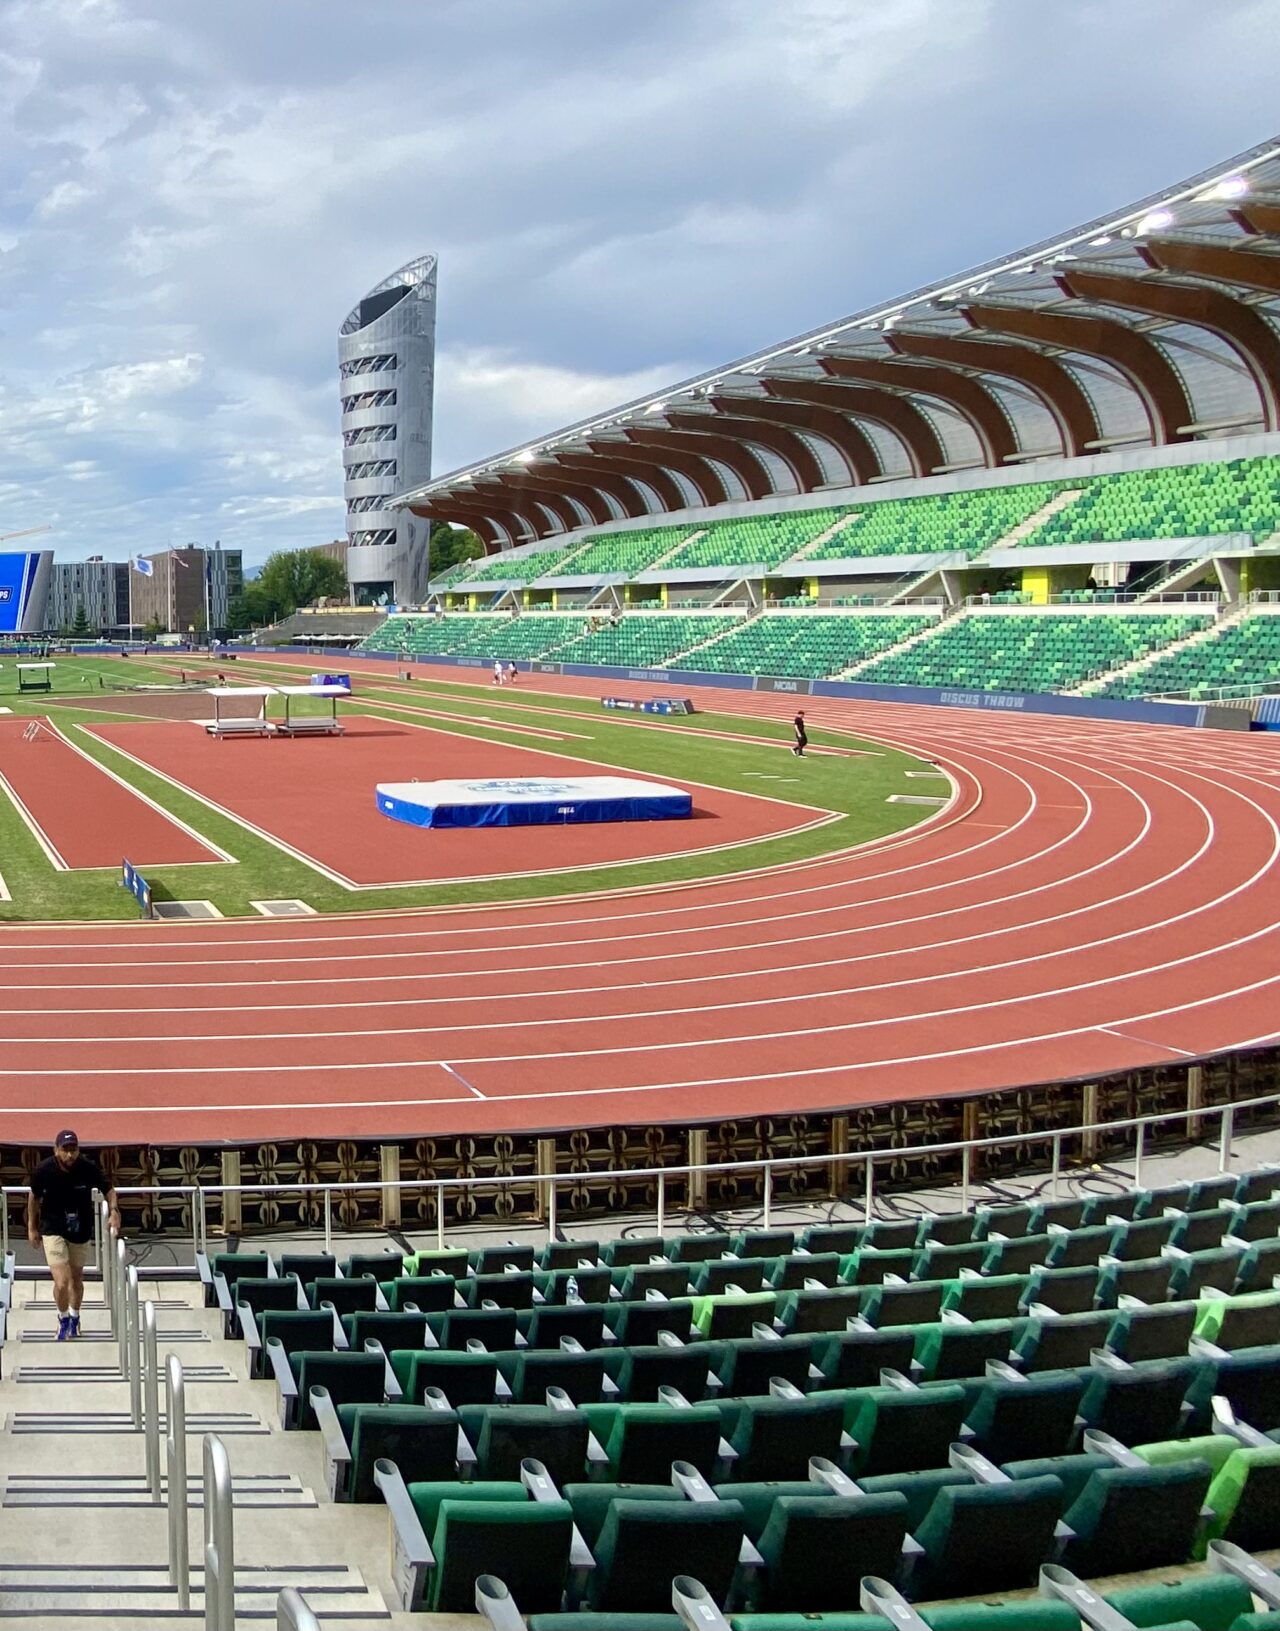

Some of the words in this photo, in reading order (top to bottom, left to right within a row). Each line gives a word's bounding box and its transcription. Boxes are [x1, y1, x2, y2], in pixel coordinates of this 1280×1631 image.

[773, 680, 797, 691] NCAA
[939, 692, 981, 705] DISCUS
[983, 694, 1025, 708] THROW
